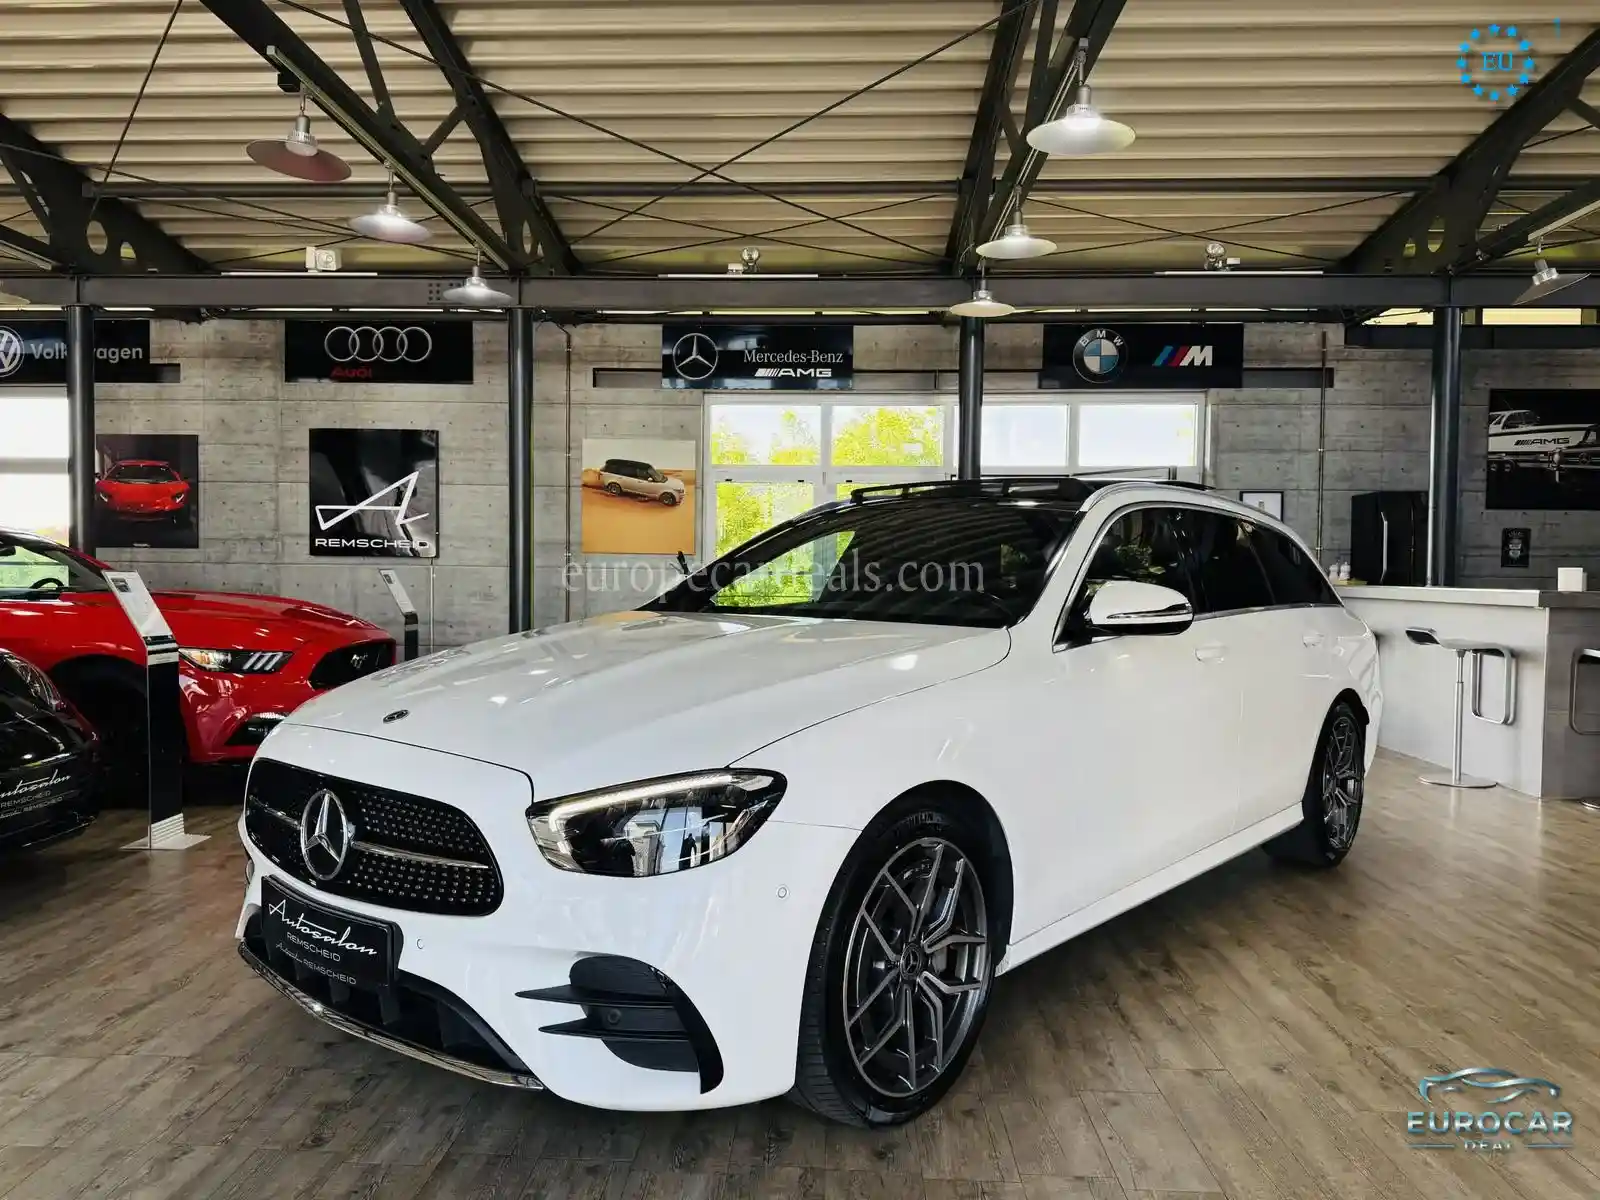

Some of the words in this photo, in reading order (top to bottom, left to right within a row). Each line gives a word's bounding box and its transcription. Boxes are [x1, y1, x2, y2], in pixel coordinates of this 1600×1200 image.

[1079, 330, 1124, 347] BMW
[30, 342, 143, 364] Volkagen
[743, 349, 844, 364] Mercedes-Benz
[331, 366, 372, 379] Audi
[778, 368, 832, 378] AMG
[1531, 437, 1570, 446] AMG
[315, 538, 430, 549] REMSCHEID
[268, 899, 378, 955] Autosalon
[286, 931, 342, 962] REMSCHEID
[303, 959, 358, 985] REMSCHEID
